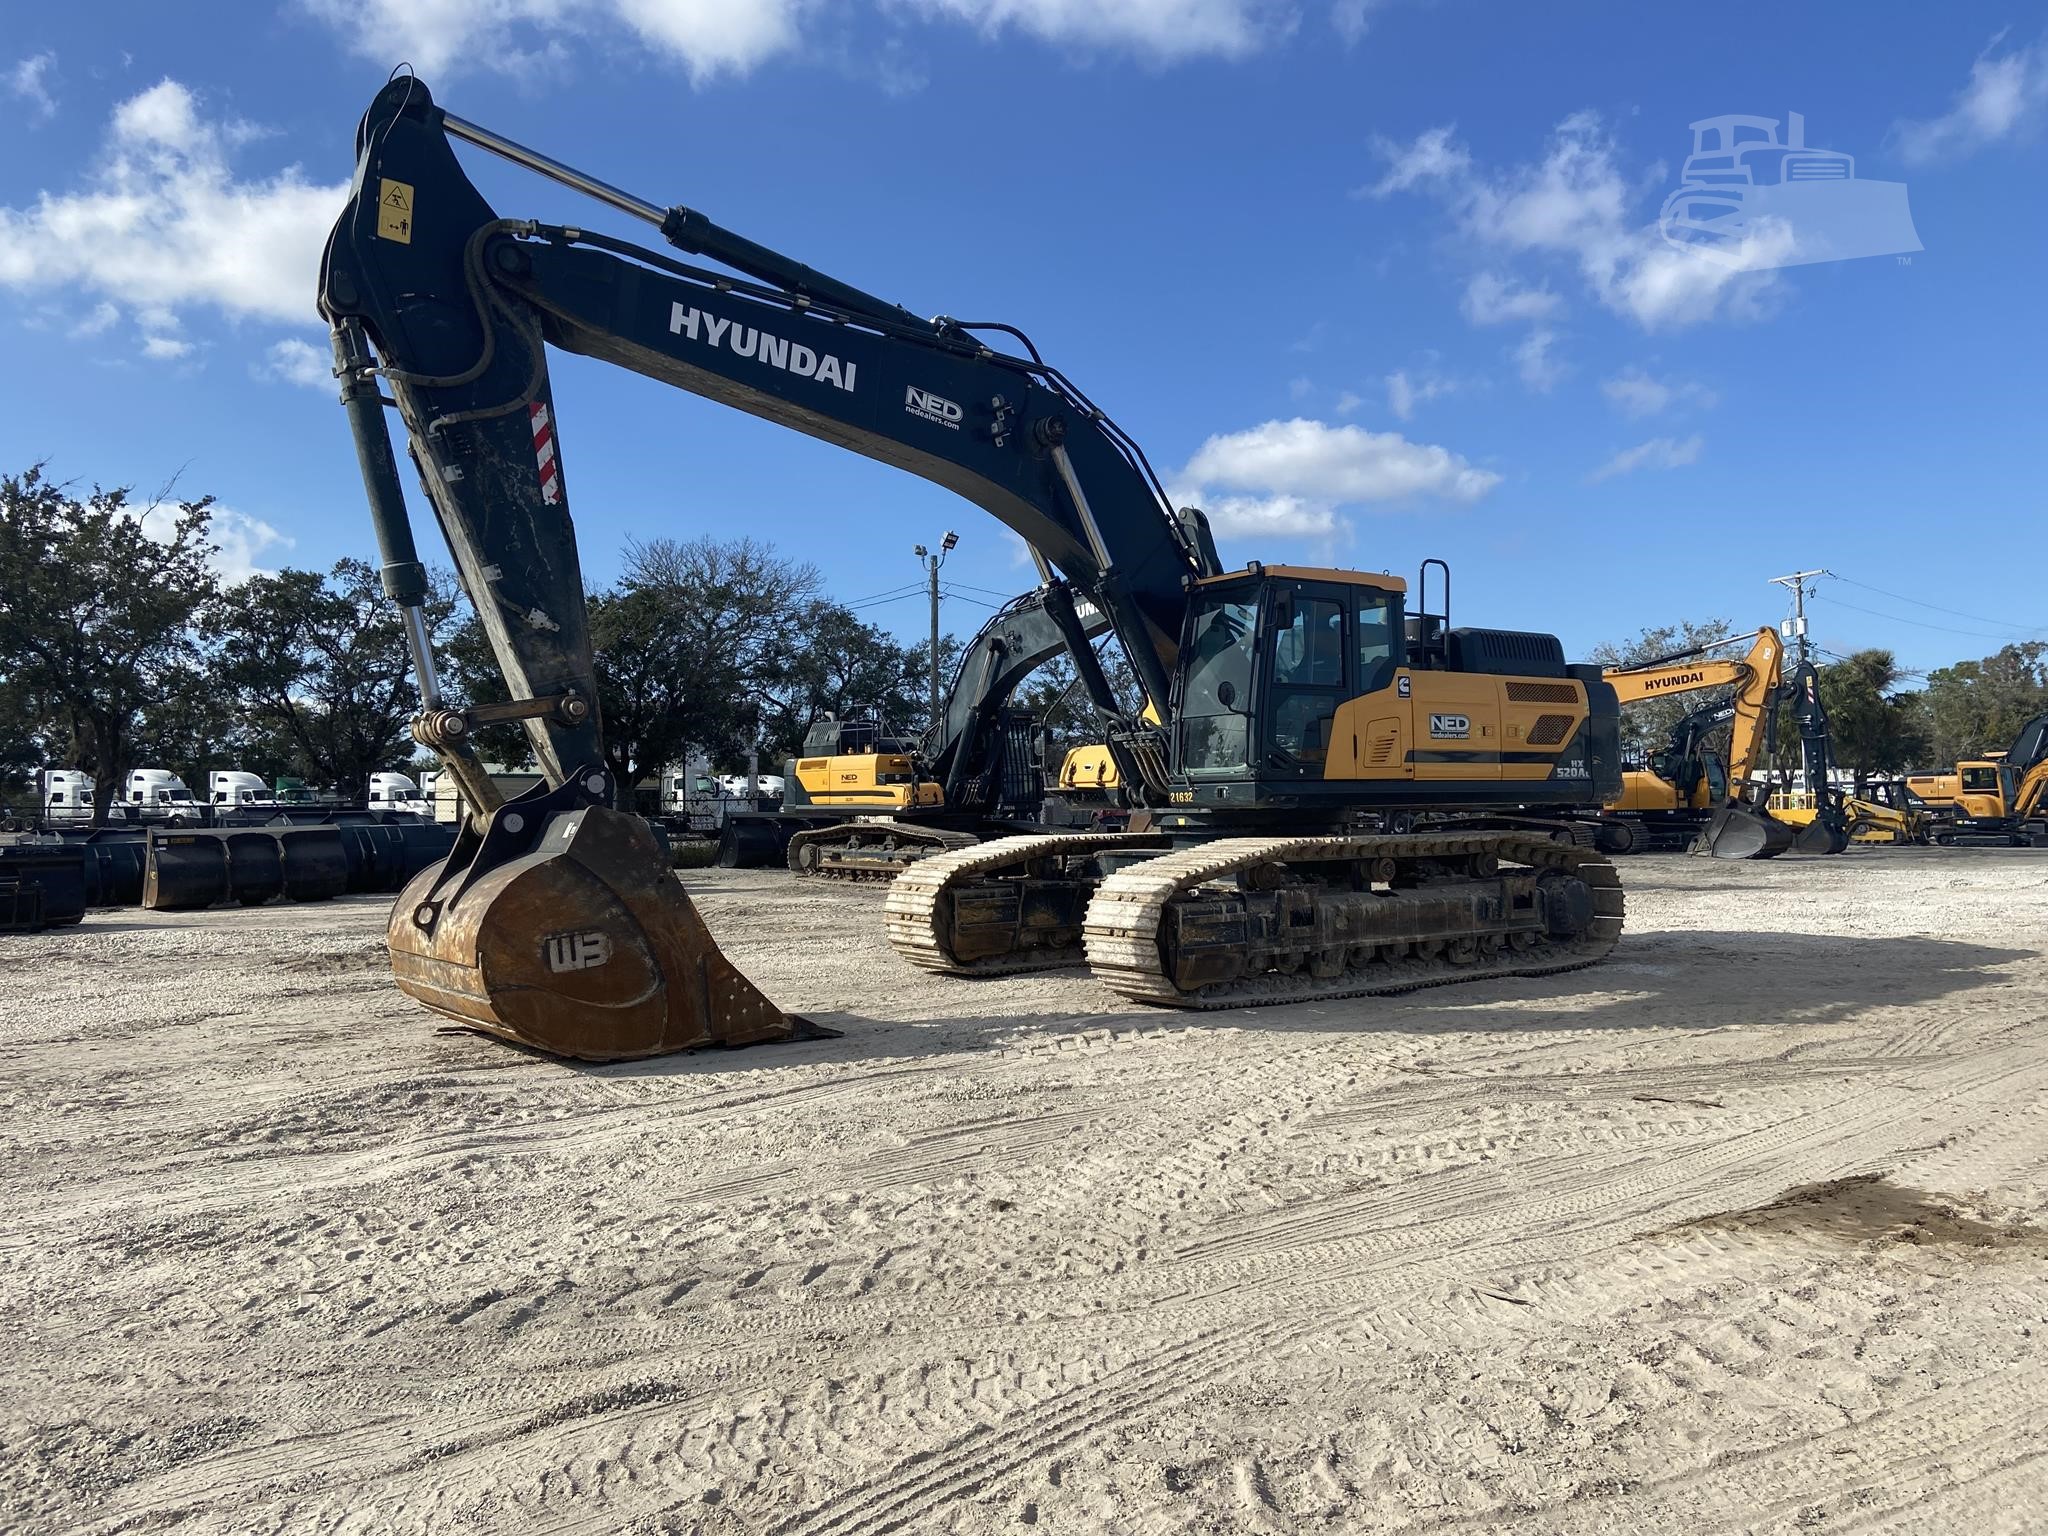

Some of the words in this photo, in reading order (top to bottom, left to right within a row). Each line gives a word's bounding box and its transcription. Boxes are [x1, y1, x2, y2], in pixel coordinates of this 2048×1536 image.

[669, 301, 857, 392] HYUNDAI
[907, 387, 962, 420] NED
[905, 405, 960, 431] nedealers.com
[1645, 671, 1704, 690] HYUNDAI
[1431, 715, 1470, 732] NED
[1713, 709, 1734, 720] NED
[1170, 792, 1193, 802] 21632
